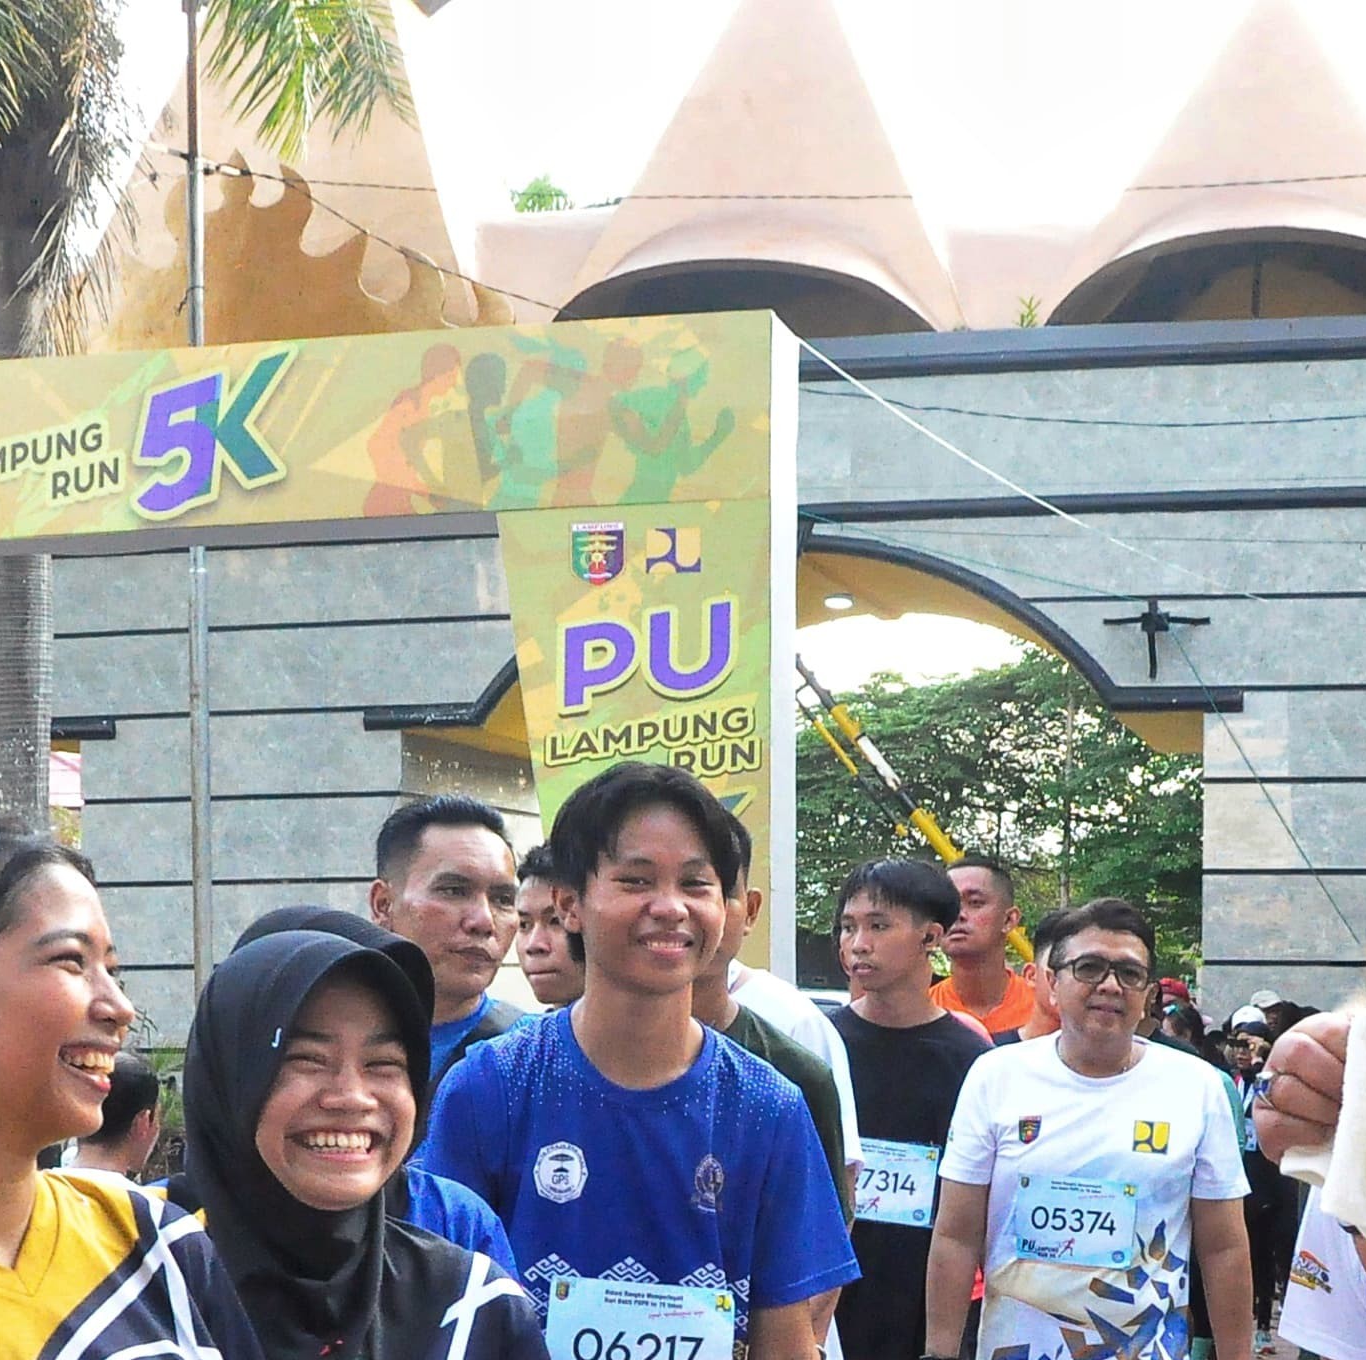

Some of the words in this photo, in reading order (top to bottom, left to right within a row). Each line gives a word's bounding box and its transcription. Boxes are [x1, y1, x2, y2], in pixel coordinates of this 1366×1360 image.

[51, 458, 120, 500] RUN
[137, 352, 288, 513] 5K
[564, 601, 731, 708] PU
[550, 706, 749, 761] LAMPUNG
[674, 741, 756, 771] RUN
[1031, 1206, 1117, 1236] 05374
